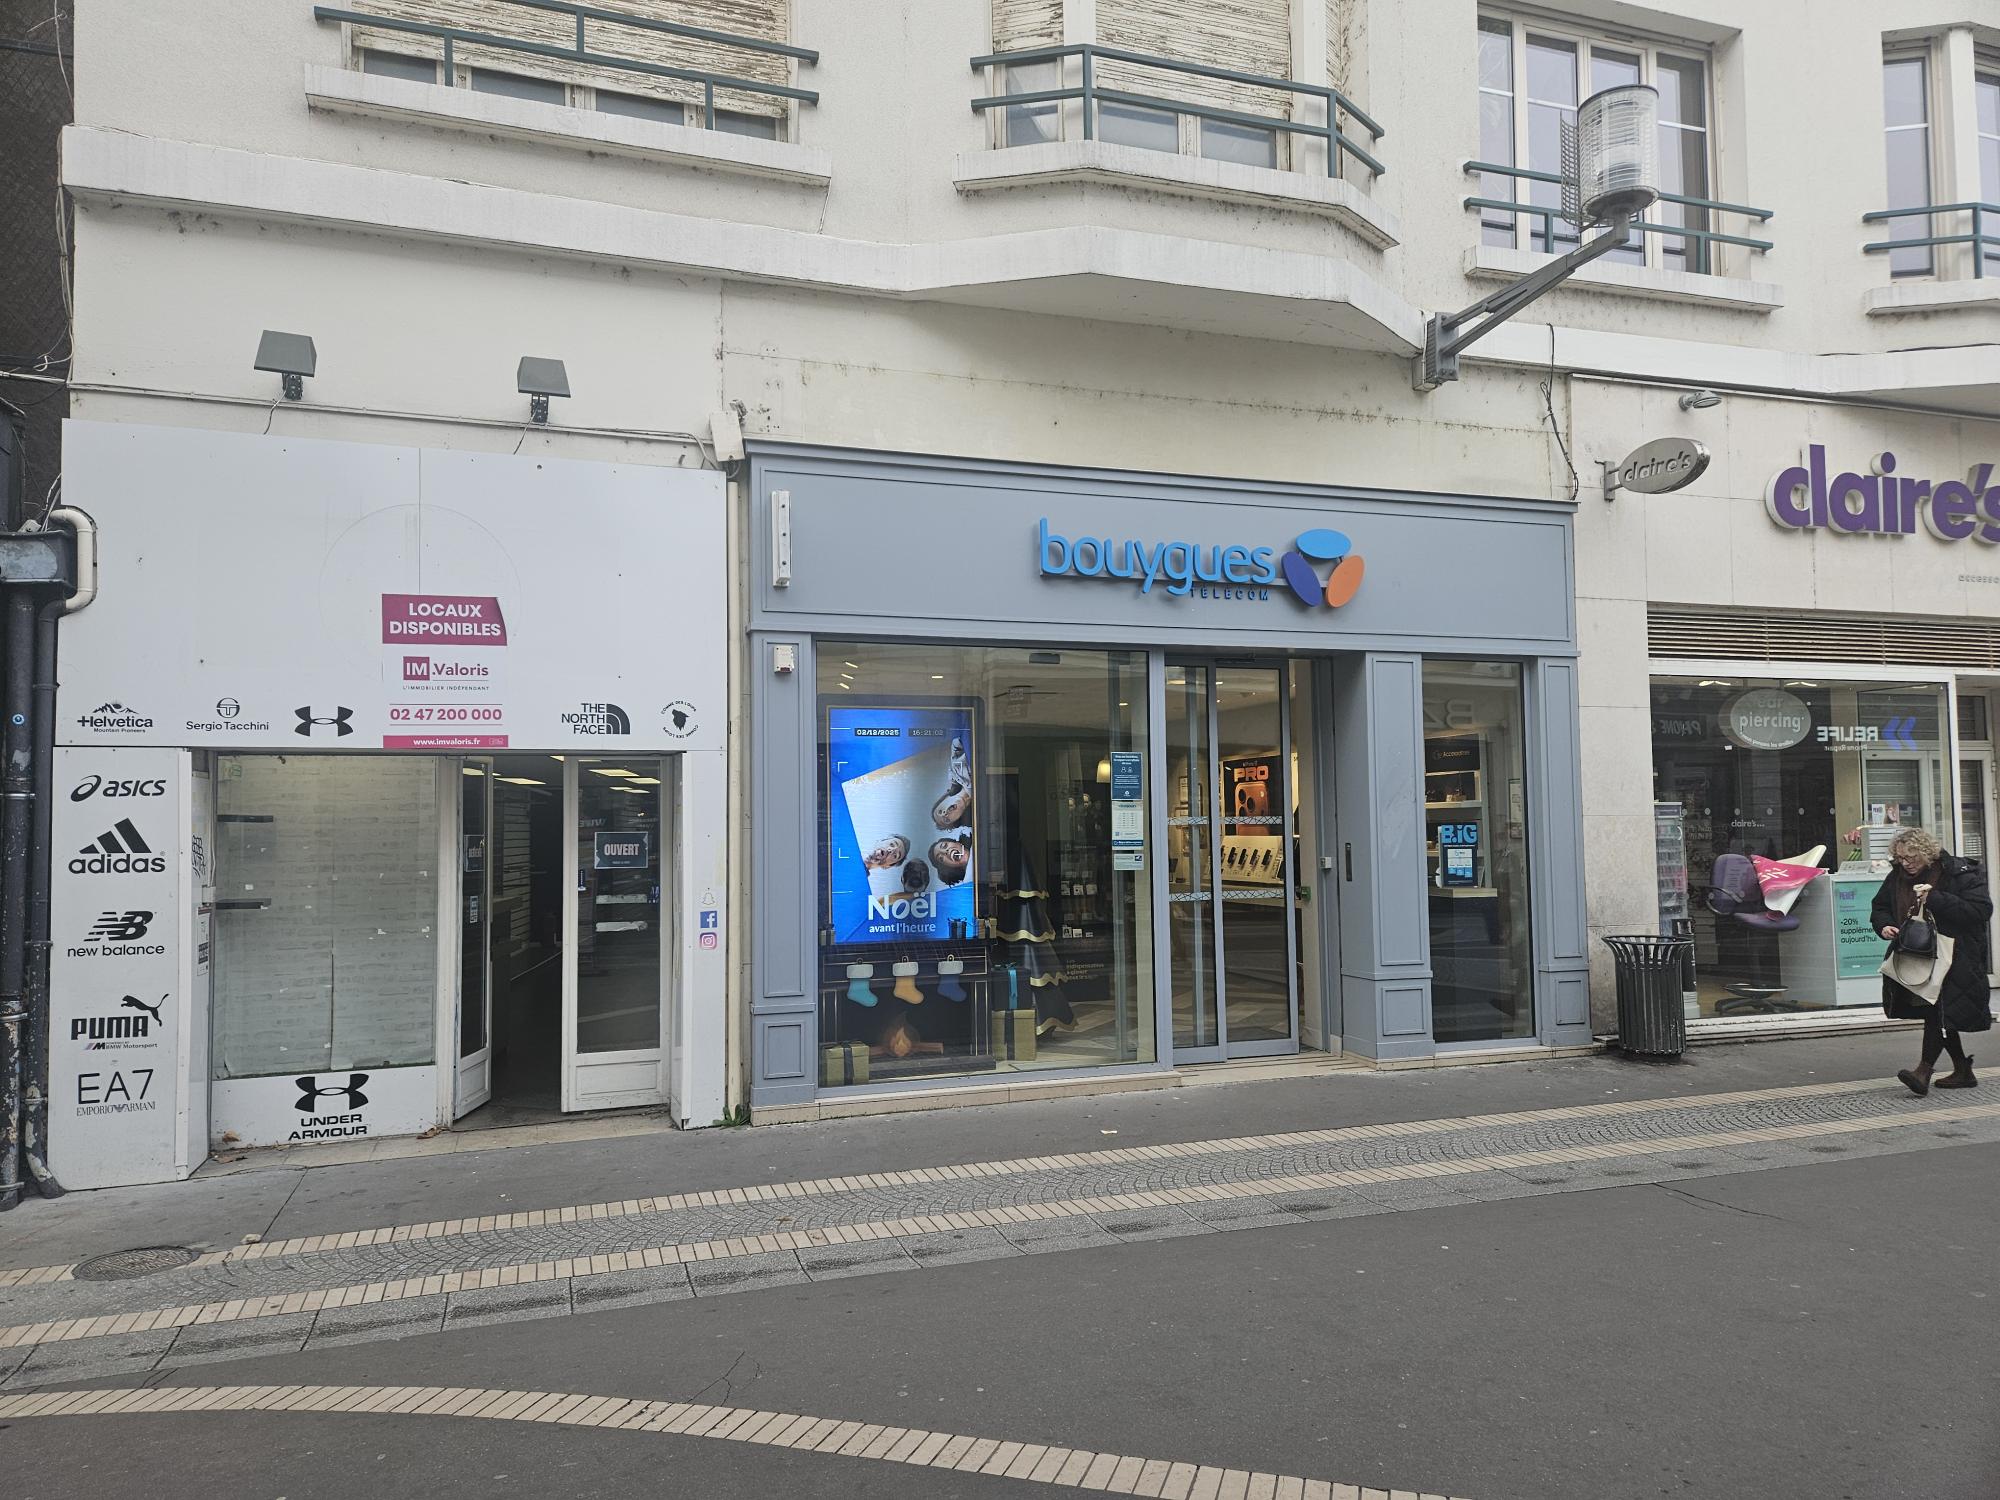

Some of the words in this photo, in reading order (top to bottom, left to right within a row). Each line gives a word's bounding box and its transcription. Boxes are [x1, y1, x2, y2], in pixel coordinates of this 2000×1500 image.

[1624, 451, 1691, 482] claire's
[1039, 517, 1276, 596] bouygues
[1190, 587, 1269, 600] TELECOM
[408, 602, 482, 618] LOCAUX
[389, 621, 501, 636] DISPONIBLES
[390, 708, 410, 720] 02
[414, 708, 433, 720] 47
[437, 708, 468, 721] 200
[471, 708, 503, 721] 000
[580, 703, 605, 713] THE
[561, 713, 605, 724] NORTH
[1739, 712, 1801, 734] piercing
[186, 721, 223, 732] Sergio
[225, 721, 269, 731] Tacchini
[573, 724, 605, 735] FACE
[413, 738, 480, 746] www.imvaloris.fr
[1233, 765, 1269, 782] PRO
[102, 780, 167, 797] asics
[604, 843, 640, 856] OUVERT
[68, 853, 166, 874] adidas
[868, 891, 937, 921] Noël
[869, 924, 896, 933] avant
[896, 922, 937, 934] l'heure
[1840, 918, 1859, 926] -20%
[1840, 935, 1878, 945] aujourd'hui
[67, 947, 98, 957] new
[102, 945, 165, 957] balance
[71, 1015, 149, 1041] PUMA
[123, 1042, 158, 1050] Motorsport
[78, 1068, 154, 1105] EA7
[76, 1104, 114, 1117] EMPORIO
[125, 1100, 156, 1112] ARMANI
[300, 1114, 363, 1127] UNDER
[288, 1125, 368, 1141] ARMOUR
